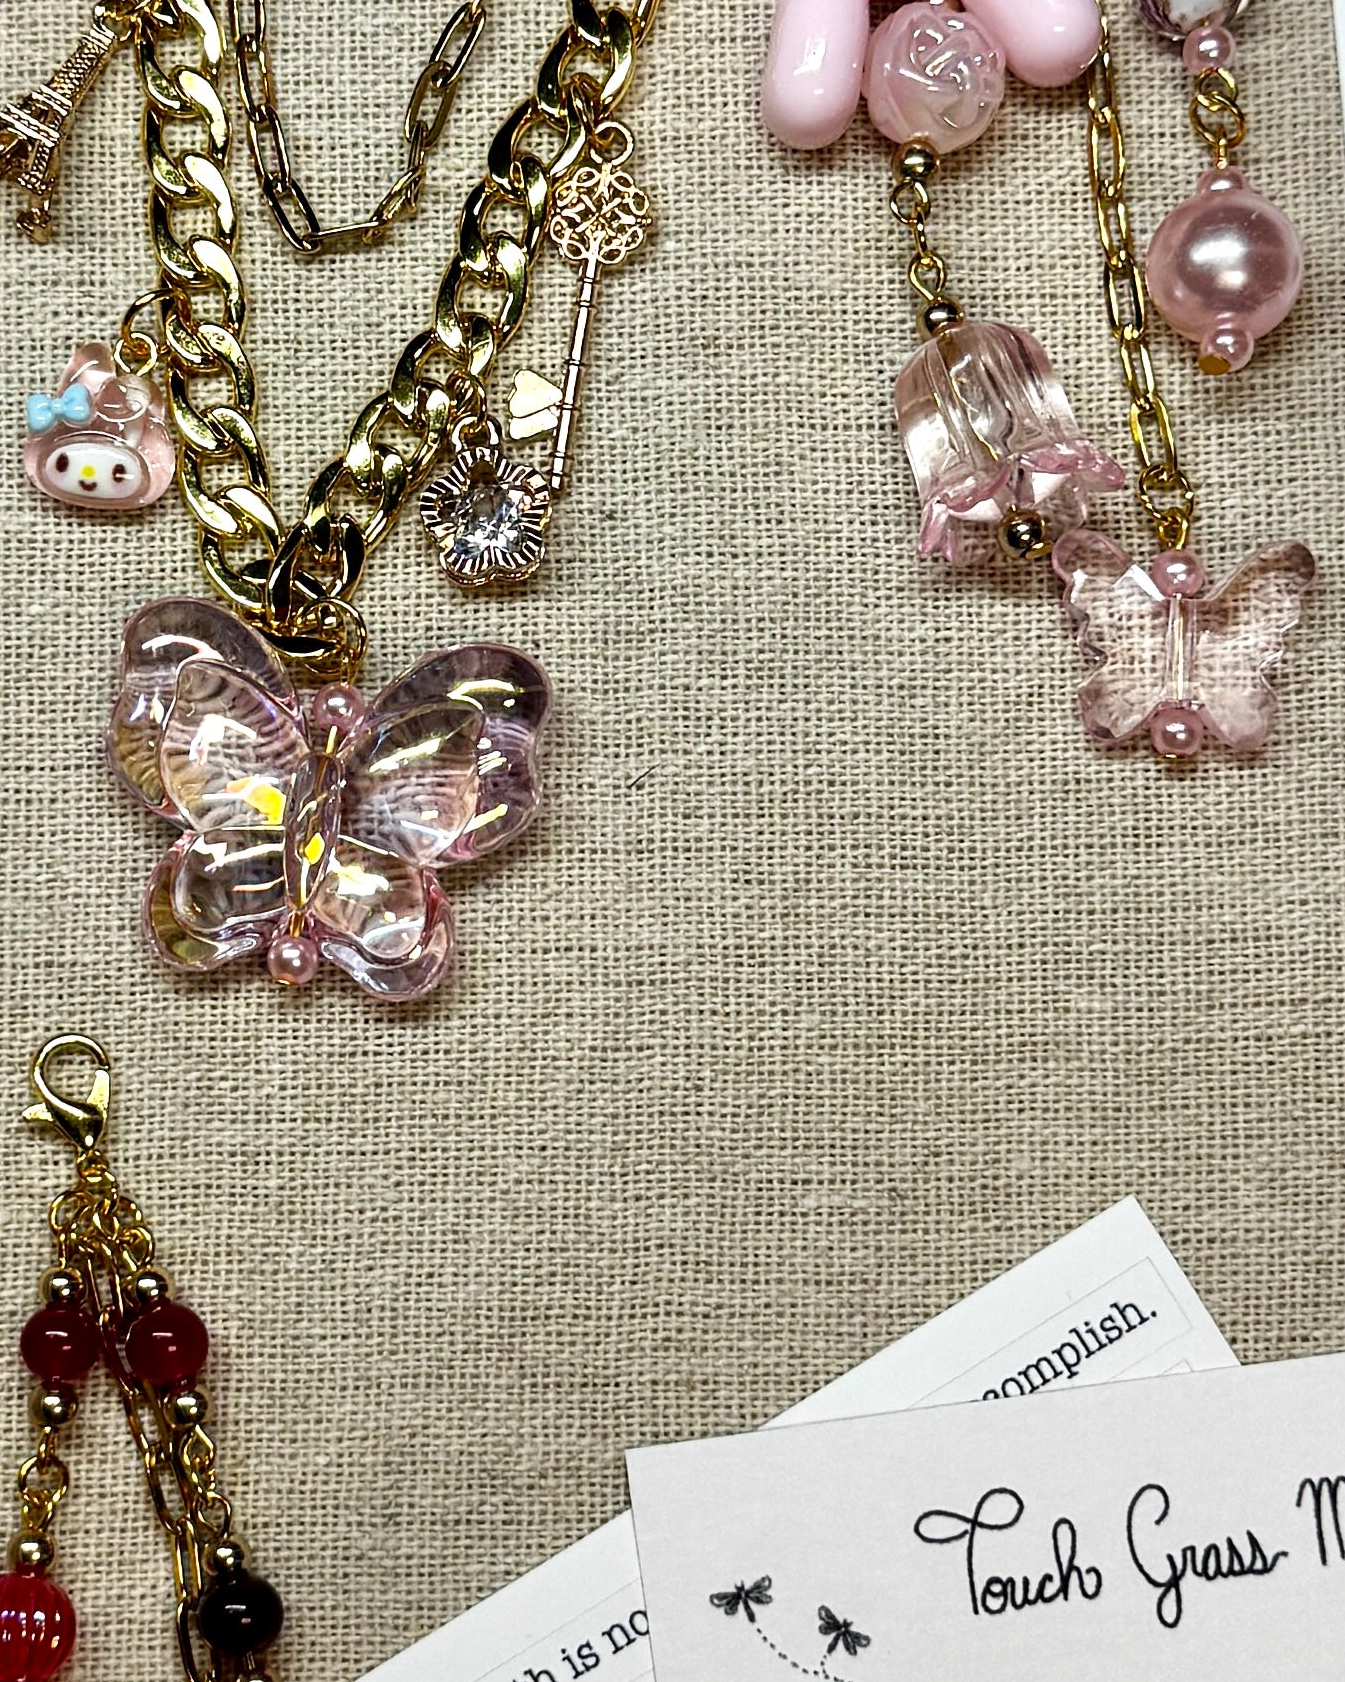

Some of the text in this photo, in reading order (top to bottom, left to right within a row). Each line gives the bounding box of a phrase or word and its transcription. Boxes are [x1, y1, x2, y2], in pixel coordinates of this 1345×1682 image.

[982, 1302, 1158, 1401] omplish.
[913, 1486, 1102, 1616] Touch
[1126, 1482, 1289, 1629] Grass
[560, 1638, 601, 1680] is
